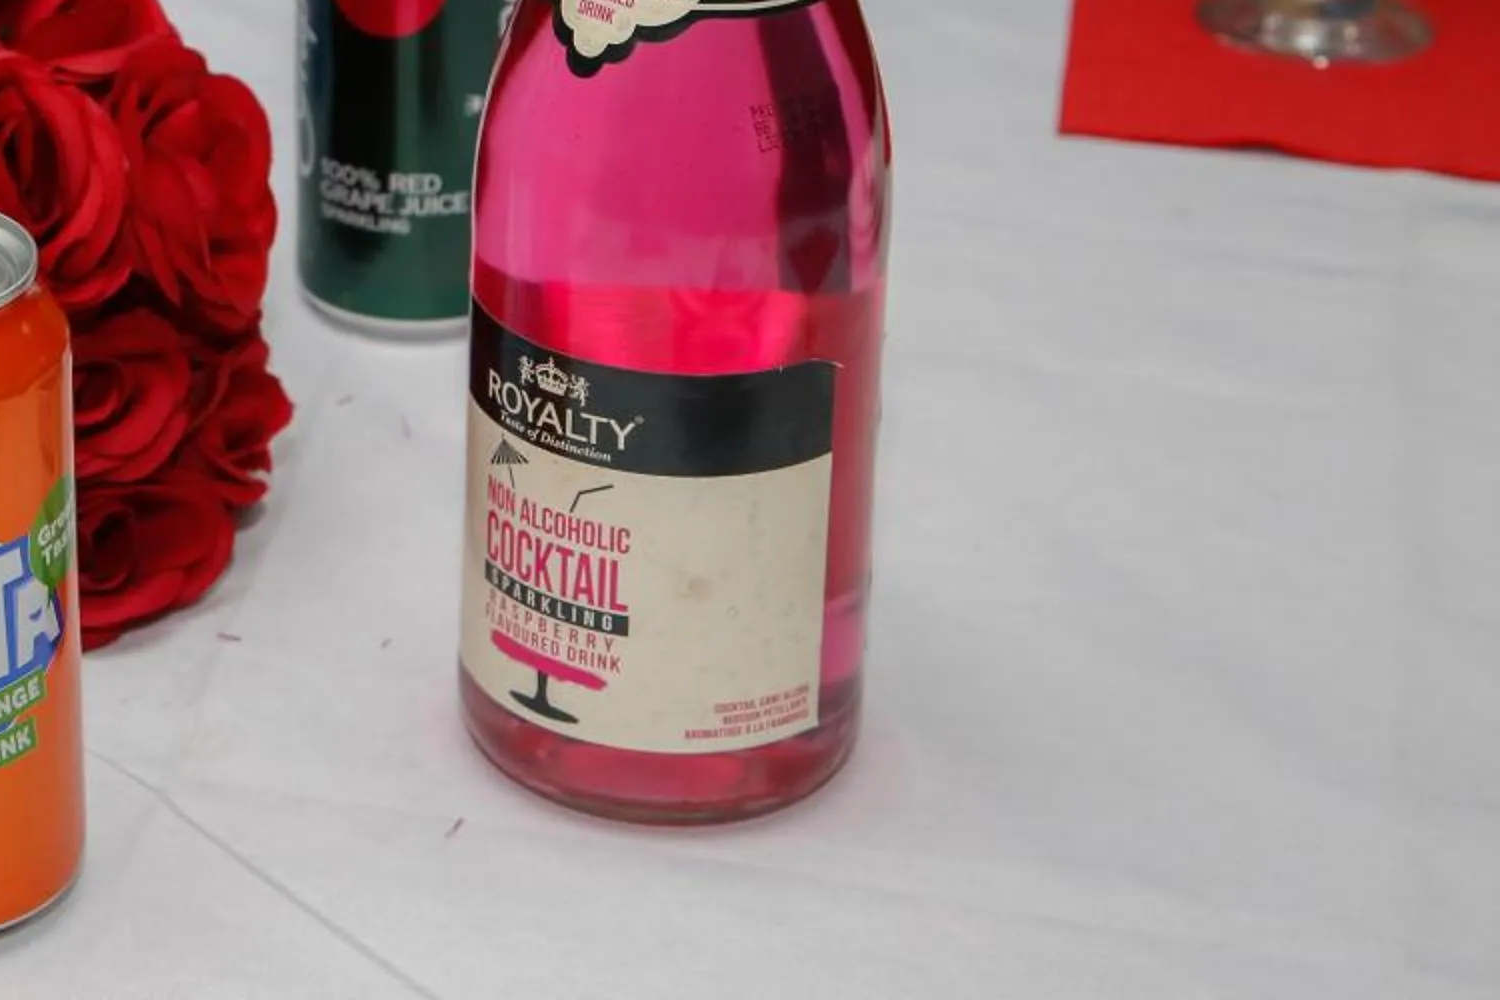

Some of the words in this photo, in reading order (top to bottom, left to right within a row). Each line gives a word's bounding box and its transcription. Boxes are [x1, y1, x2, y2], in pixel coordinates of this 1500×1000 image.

[320, 179, 395, 214] GRAPE
[400, 190, 469, 217] JUICE
[321, 156, 381, 191] 100%
[389, 173, 443, 194] RED
[488, 368, 636, 450] ROYALTY
[501, 410, 526, 433] Taste
[527, 428, 540, 442] of
[540, 433, 611, 463] Distinction
[488, 475, 516, 517] NON
[520, 497, 631, 554] ALCOHOLIC
[487, 509, 628, 612] COCKTAIL
[488, 589, 616, 652] RASPBERRY
[491, 569, 613, 631] SPARKLING
[485, 602, 561, 656] FLAVOURED
[566, 647, 621, 674] DRINK
